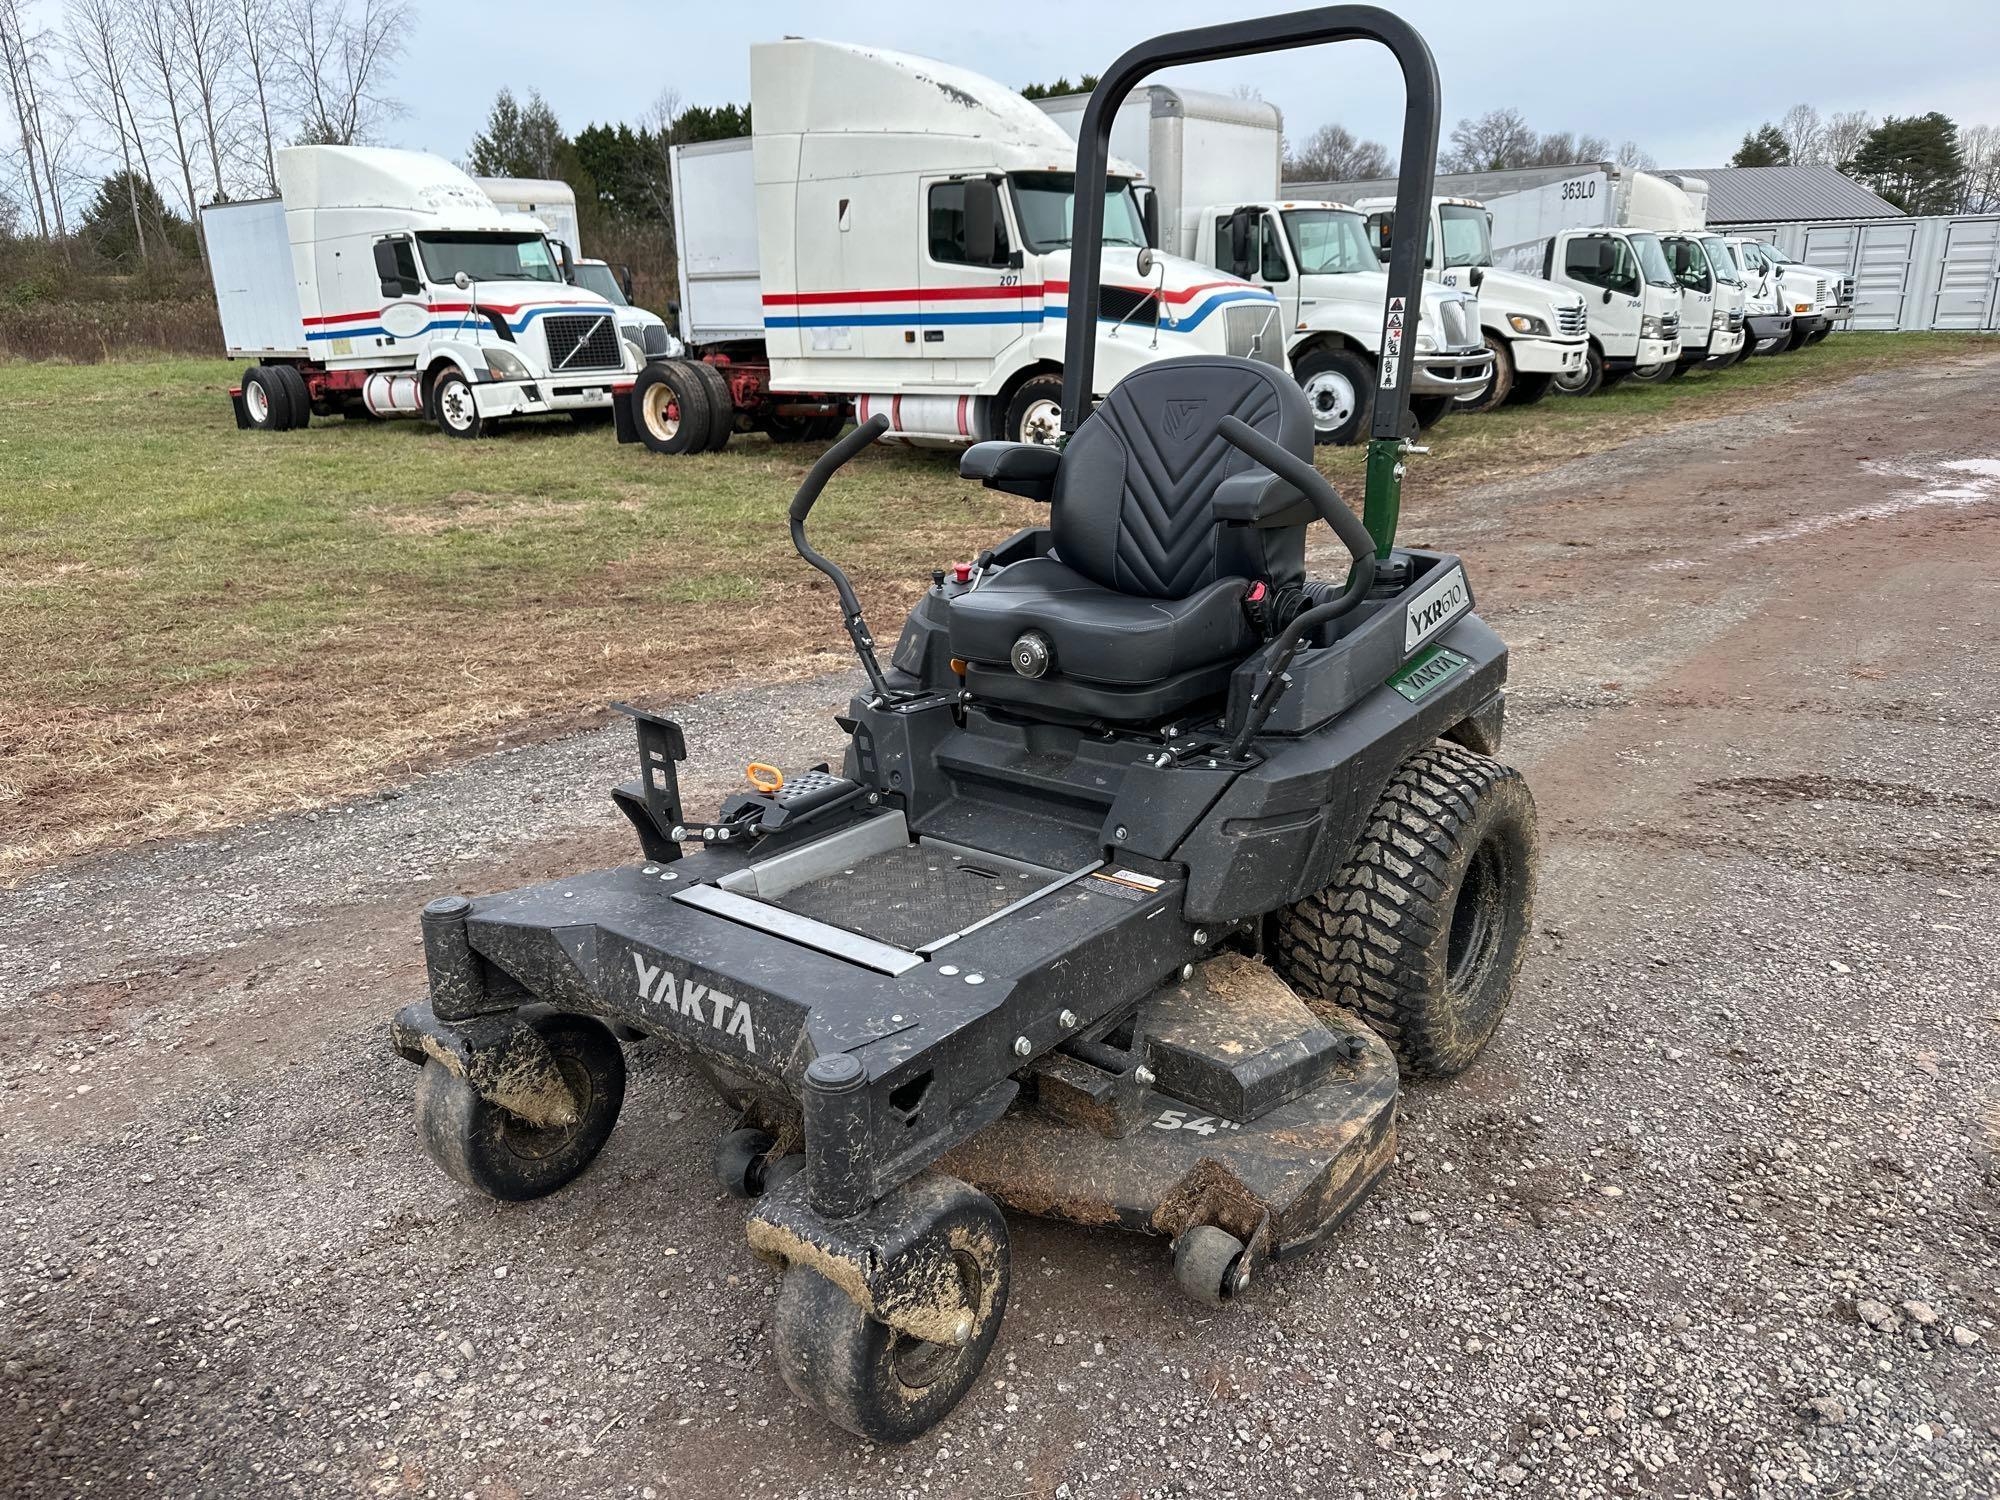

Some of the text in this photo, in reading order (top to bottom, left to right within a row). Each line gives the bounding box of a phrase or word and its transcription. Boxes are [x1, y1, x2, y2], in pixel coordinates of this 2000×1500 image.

[1562, 181, 1595, 200] 363L0
[1000, 275, 1018, 286] 207
[1443, 275, 1457, 287] 453
[1627, 300, 1642, 308] 706
[1698, 295, 1712, 303] 715
[1410, 584, 1461, 636] YXR610
[1401, 656, 1461, 690] YAKTA
[633, 952, 756, 1054] YAKTA
[1152, 1109, 1240, 1136] 54"
